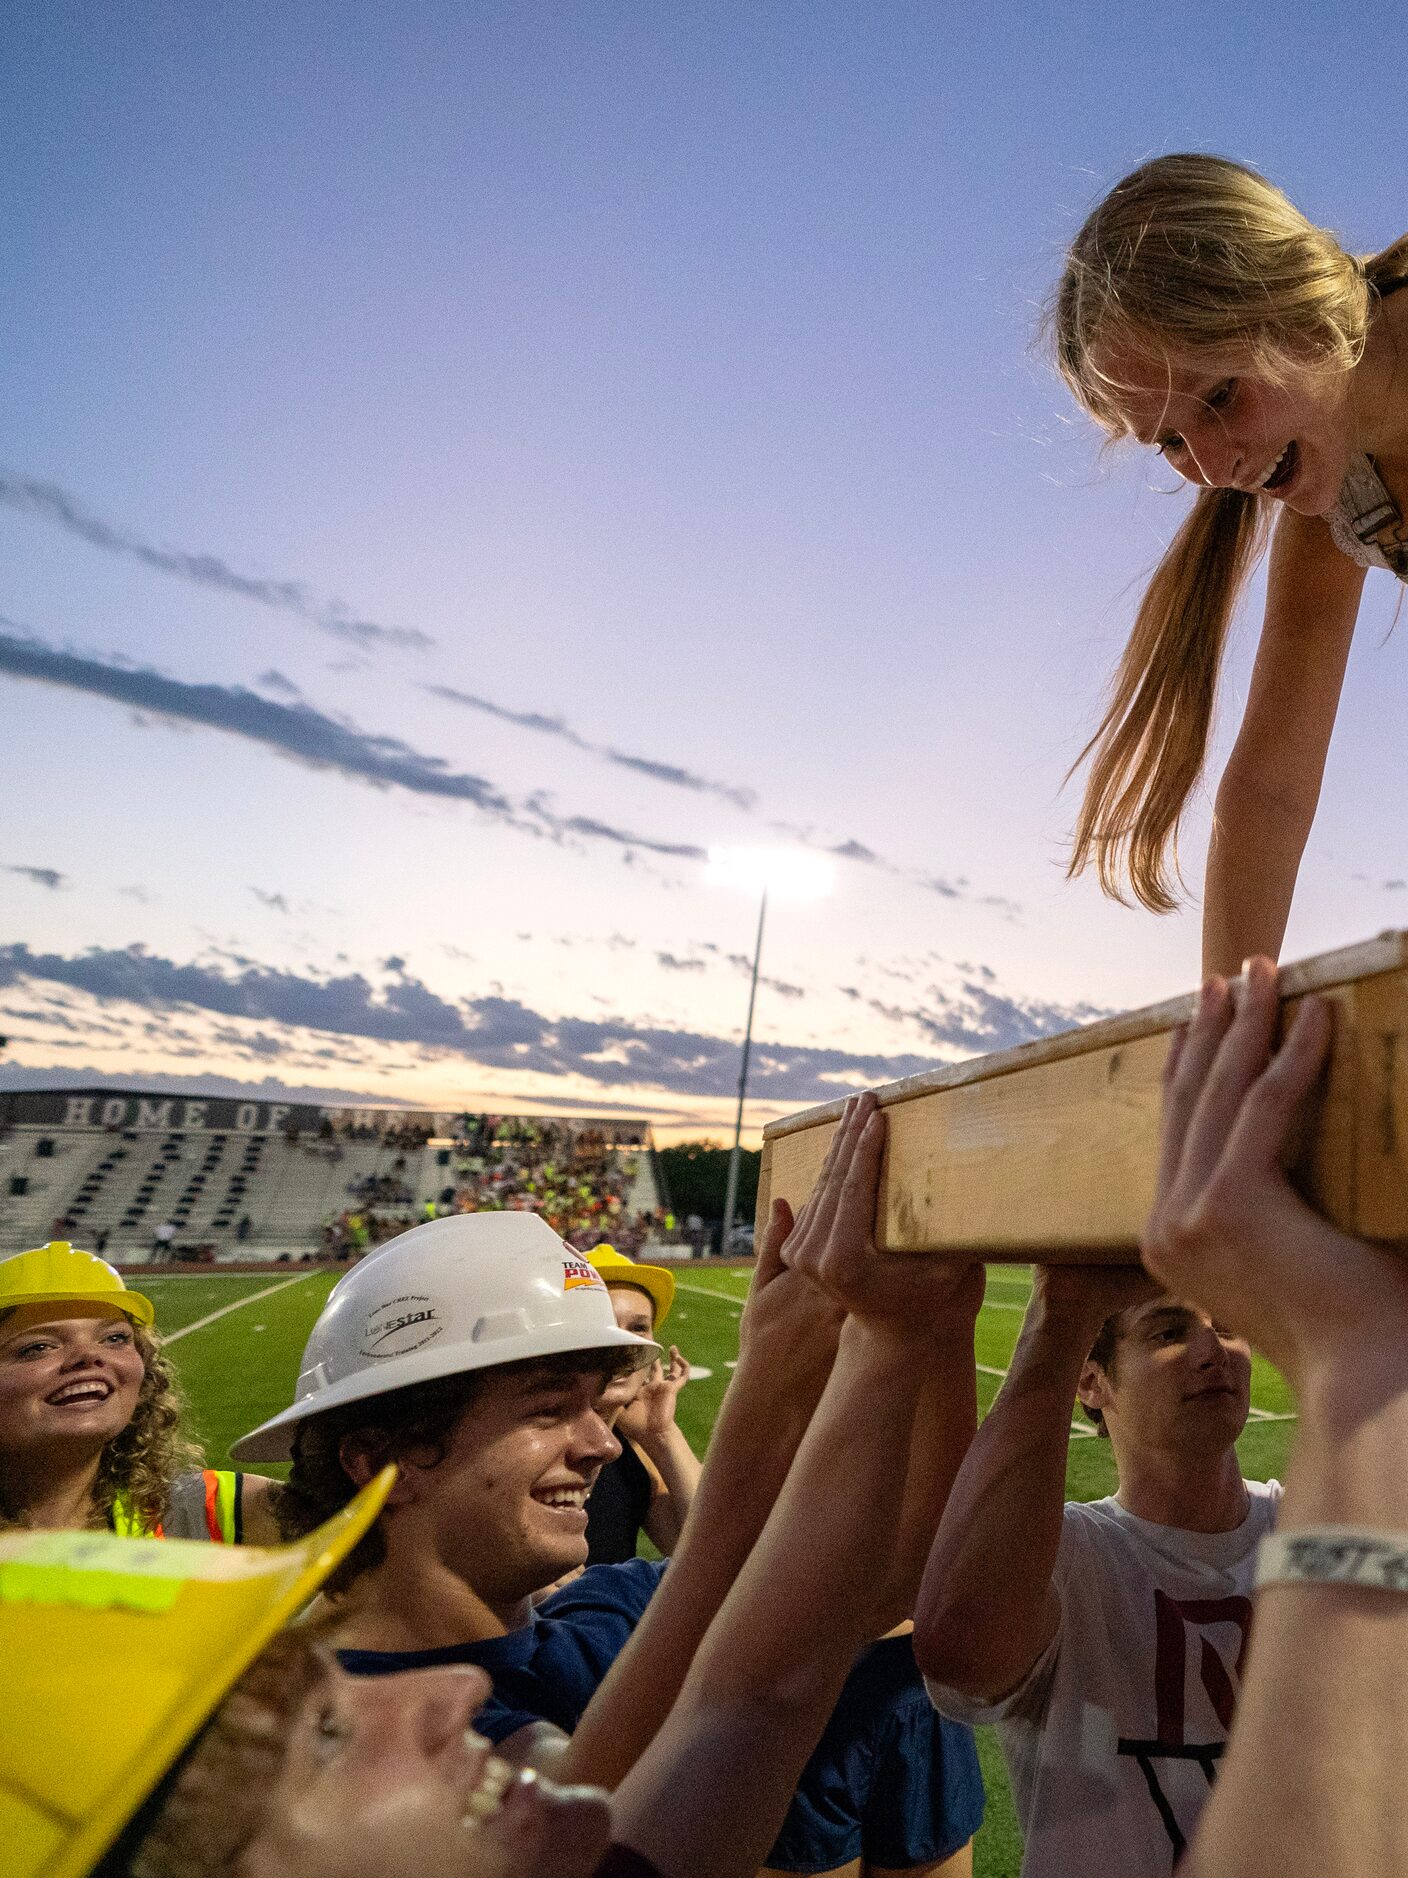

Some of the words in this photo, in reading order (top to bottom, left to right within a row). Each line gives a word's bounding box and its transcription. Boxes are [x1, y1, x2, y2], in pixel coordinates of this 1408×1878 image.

[61, 1096, 209, 1130] HOME
[235, 1103, 291, 1131] OF
[562, 1261, 588, 1270] TEAM
